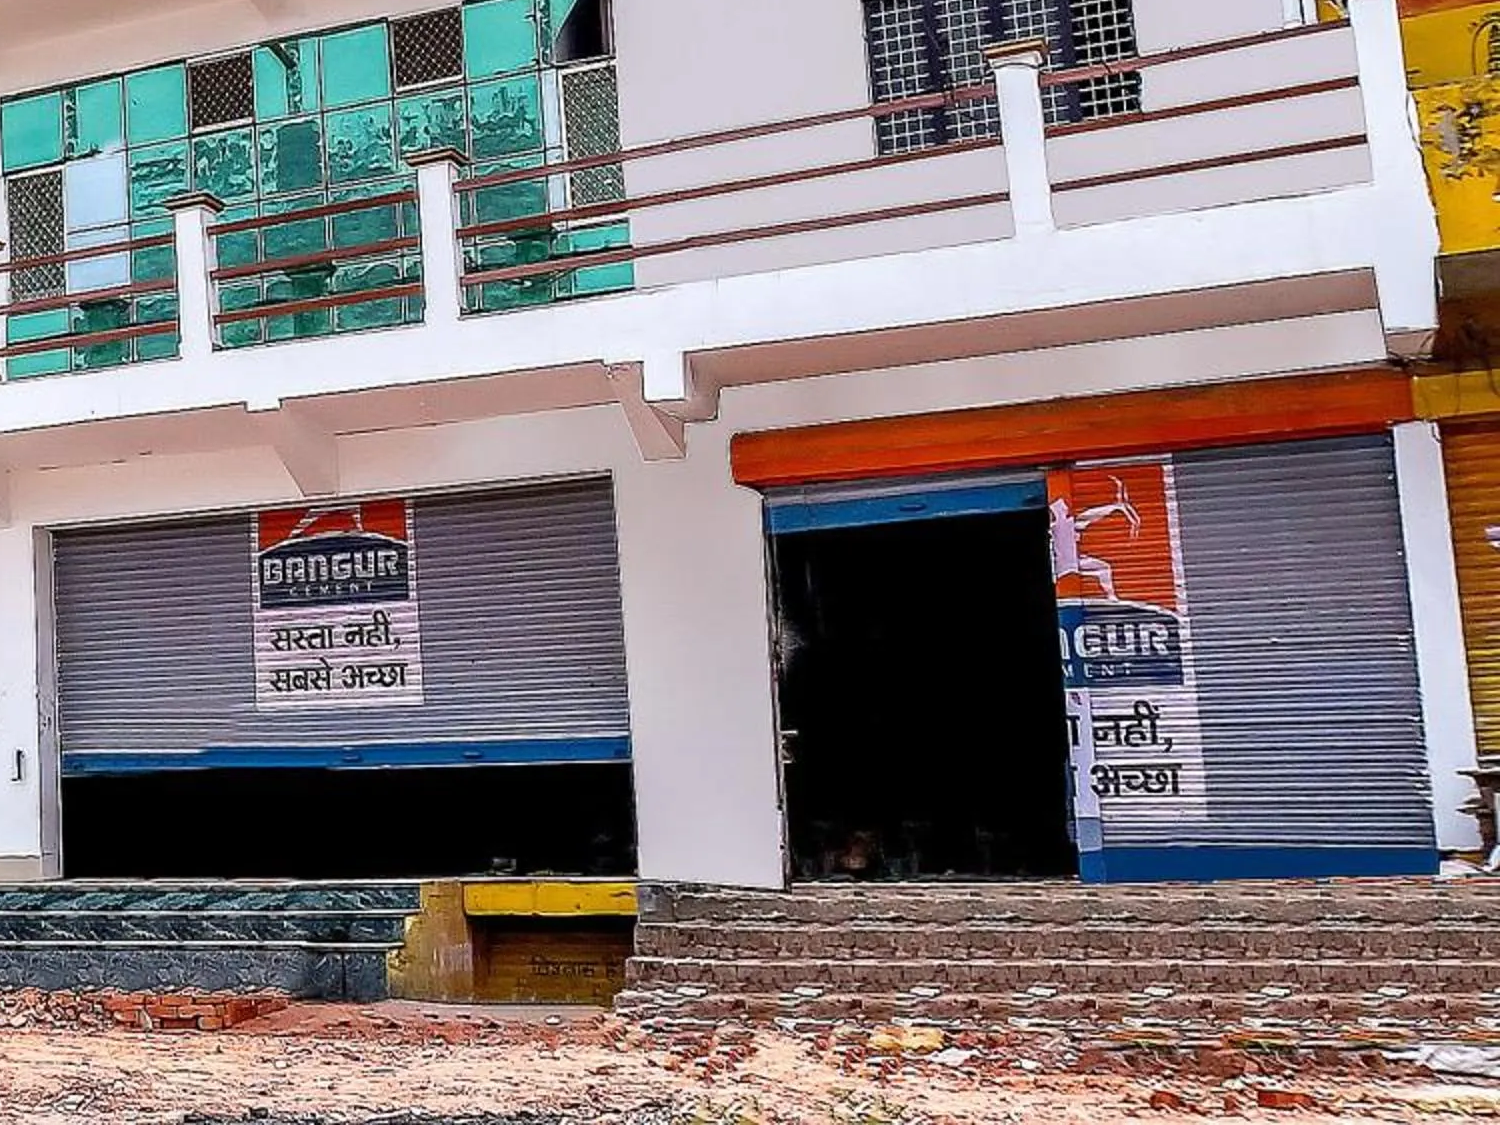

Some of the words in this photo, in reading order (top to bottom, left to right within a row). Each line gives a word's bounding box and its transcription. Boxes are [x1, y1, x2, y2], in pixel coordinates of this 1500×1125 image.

[263, 550, 399, 585] BANGUR
[270, 624, 334, 652] सस्ता
[269, 657, 333, 693] सबसे
[341, 663, 409, 689] अच्छा
[1090, 764, 1182, 794] अच्छा
